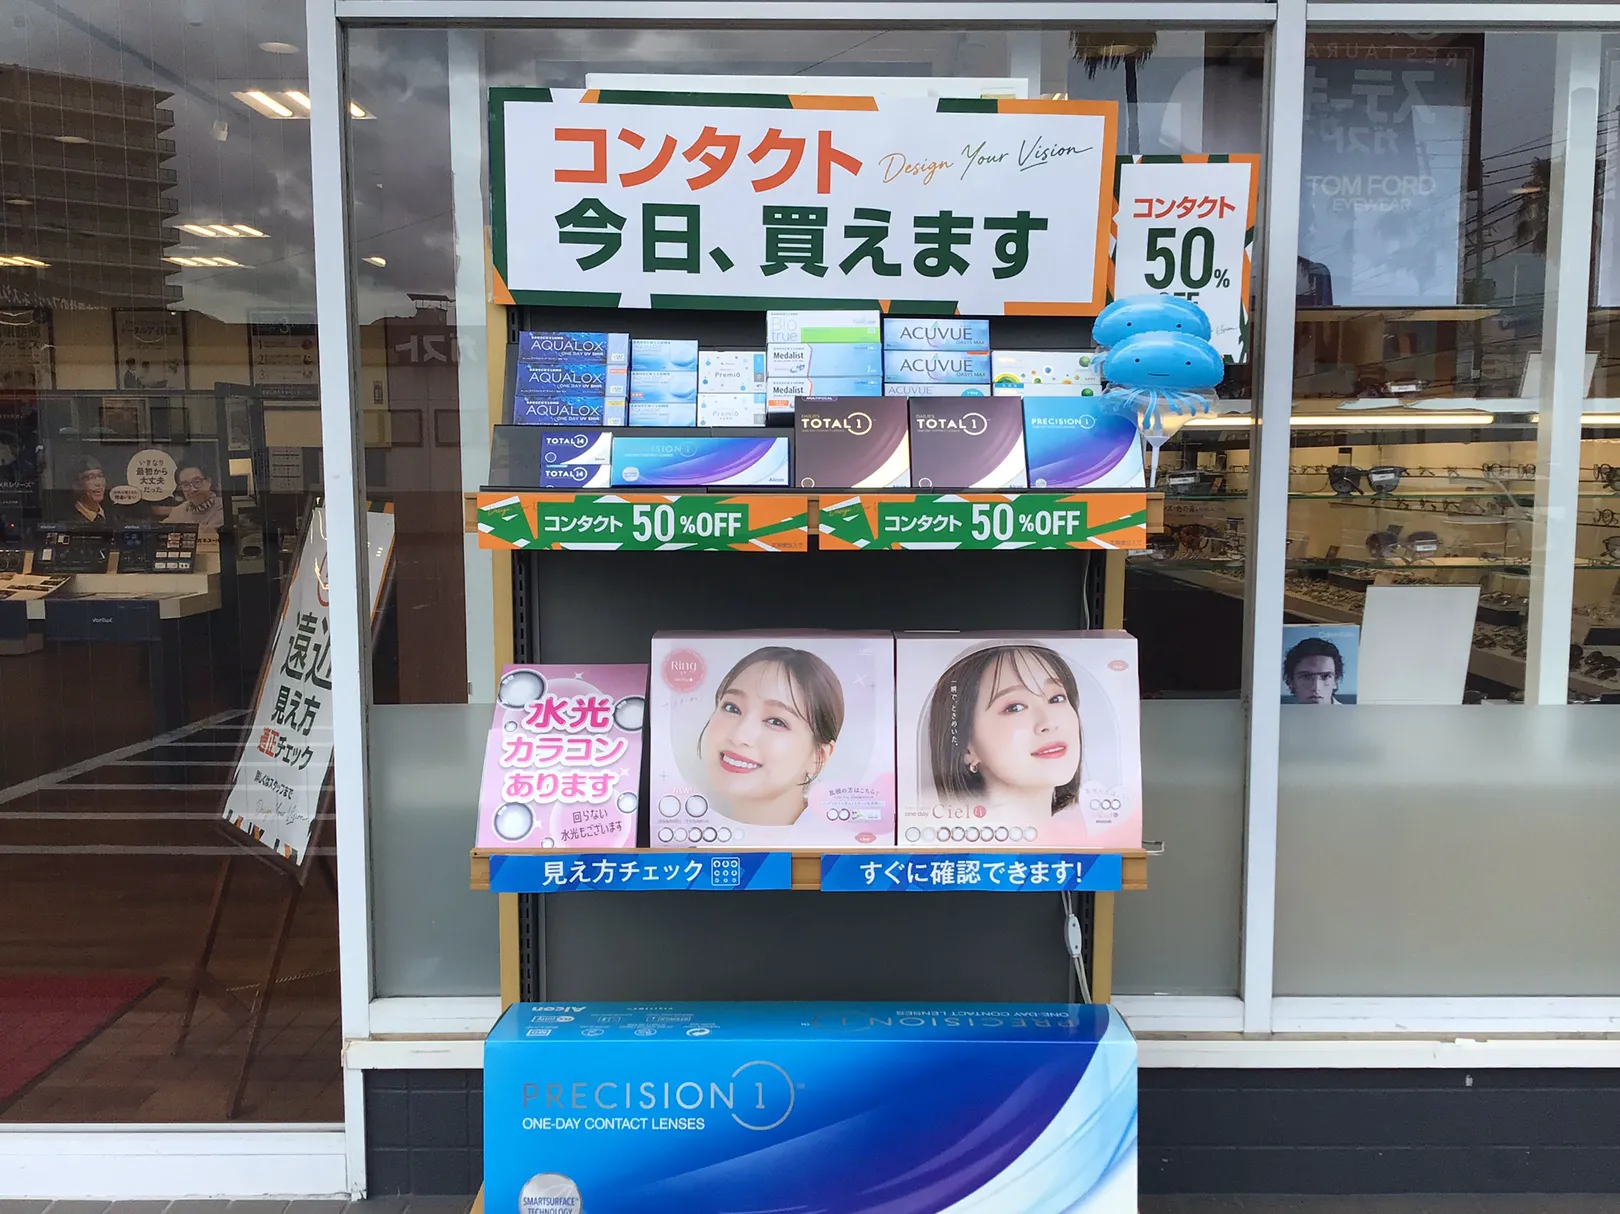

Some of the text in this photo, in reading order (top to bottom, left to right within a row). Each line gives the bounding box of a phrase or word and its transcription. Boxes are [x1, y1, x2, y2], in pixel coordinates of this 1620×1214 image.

[554, 125, 863, 194] コンタクト
[878, 136, 1093, 185] Design Your Vision
[1307, 175, 1436, 196] TOM FORD
[1133, 196, 1236, 219] コンタクト
[1332, 198, 1412, 211] EYEWEAR
[554, 197, 1049, 279] 今日、買えます
[771, 331, 798, 341] true
[900, 327, 973, 340] ACUVUE
[531, 340, 604, 351] AQUALOX
[900, 359, 974, 372] ACUVUE
[529, 372, 602, 383] AQUALOX
[888, 386, 932, 394] ACUVUE
[526, 405, 600, 416] AQUALOX
[801, 419, 851, 428] TOTAL
[916, 419, 966, 428] TOTAL
[136, 468, 168, 476] 最初から
[140, 477, 165, 485] 大丈夫
[544, 515, 623, 532] コンタクト
[884, 514, 962, 532] コンタクト
[670, 660, 697, 672] Ring
[271, 686, 320, 737] 見え方
[526, 697, 611, 728] 水光
[504, 737, 625, 762] カラコン
[506, 772, 615, 798] あります
[572, 809, 608, 824] 回らない
[932, 804, 970, 819] Ciel
[561, 820, 622, 841] 水光もございます
[542, 858, 703, 886] 見え方チェック
[860, 859, 1082, 886] すぐに確認できます!
[869, 1017, 1074, 1027] PRECISION
[522, 1082, 765, 1110] PRECISION 1
[522, 1117, 705, 1130] ONE-DAY CONTACT LENSES
